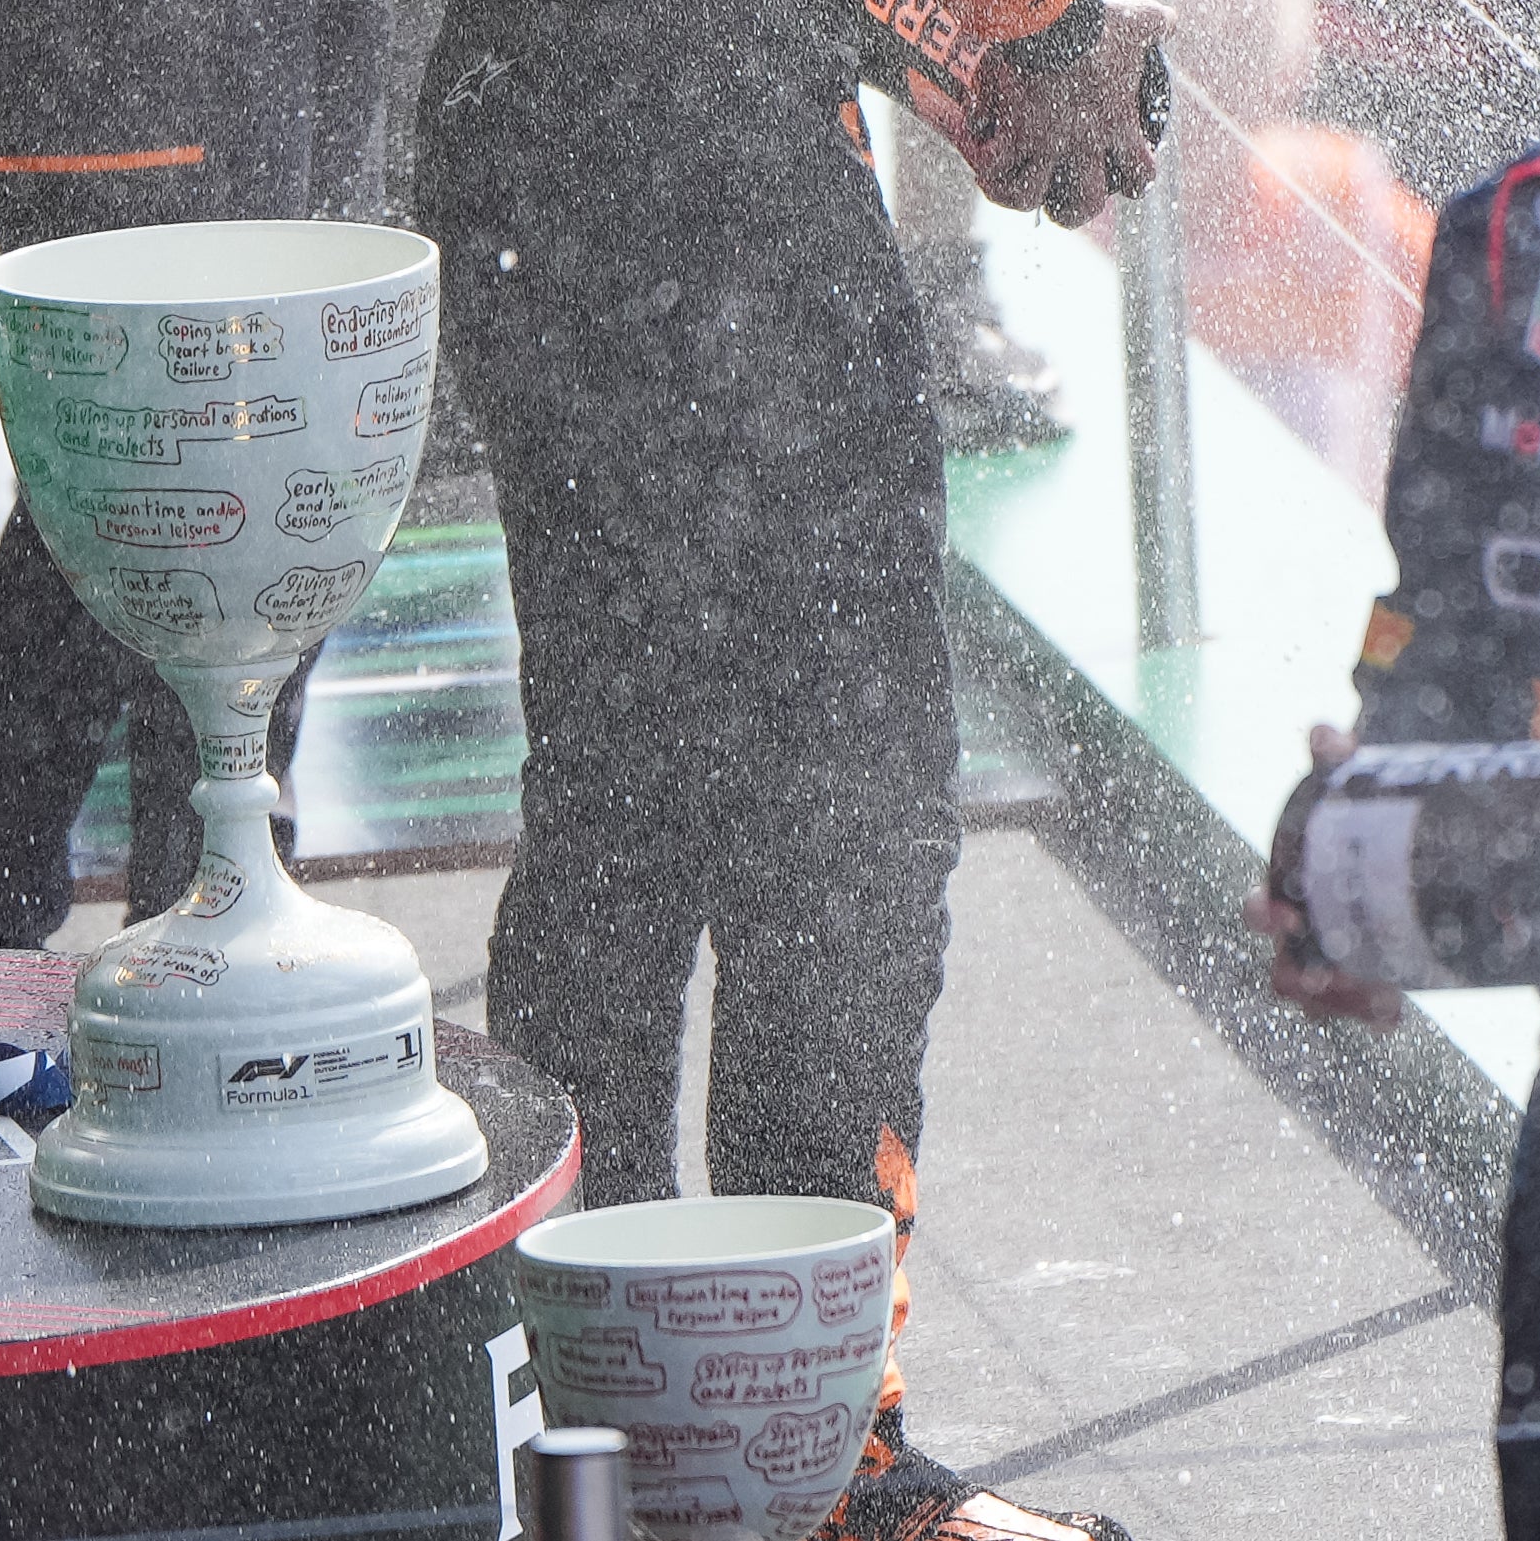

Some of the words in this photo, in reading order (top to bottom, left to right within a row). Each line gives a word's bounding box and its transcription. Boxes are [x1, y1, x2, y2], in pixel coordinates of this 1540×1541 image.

[327, 305, 395, 334] enduring
[167, 339, 209, 359] heart
[330, 334, 358, 353] and
[296, 496, 324, 512] and
[157, 572, 172, 593] of
